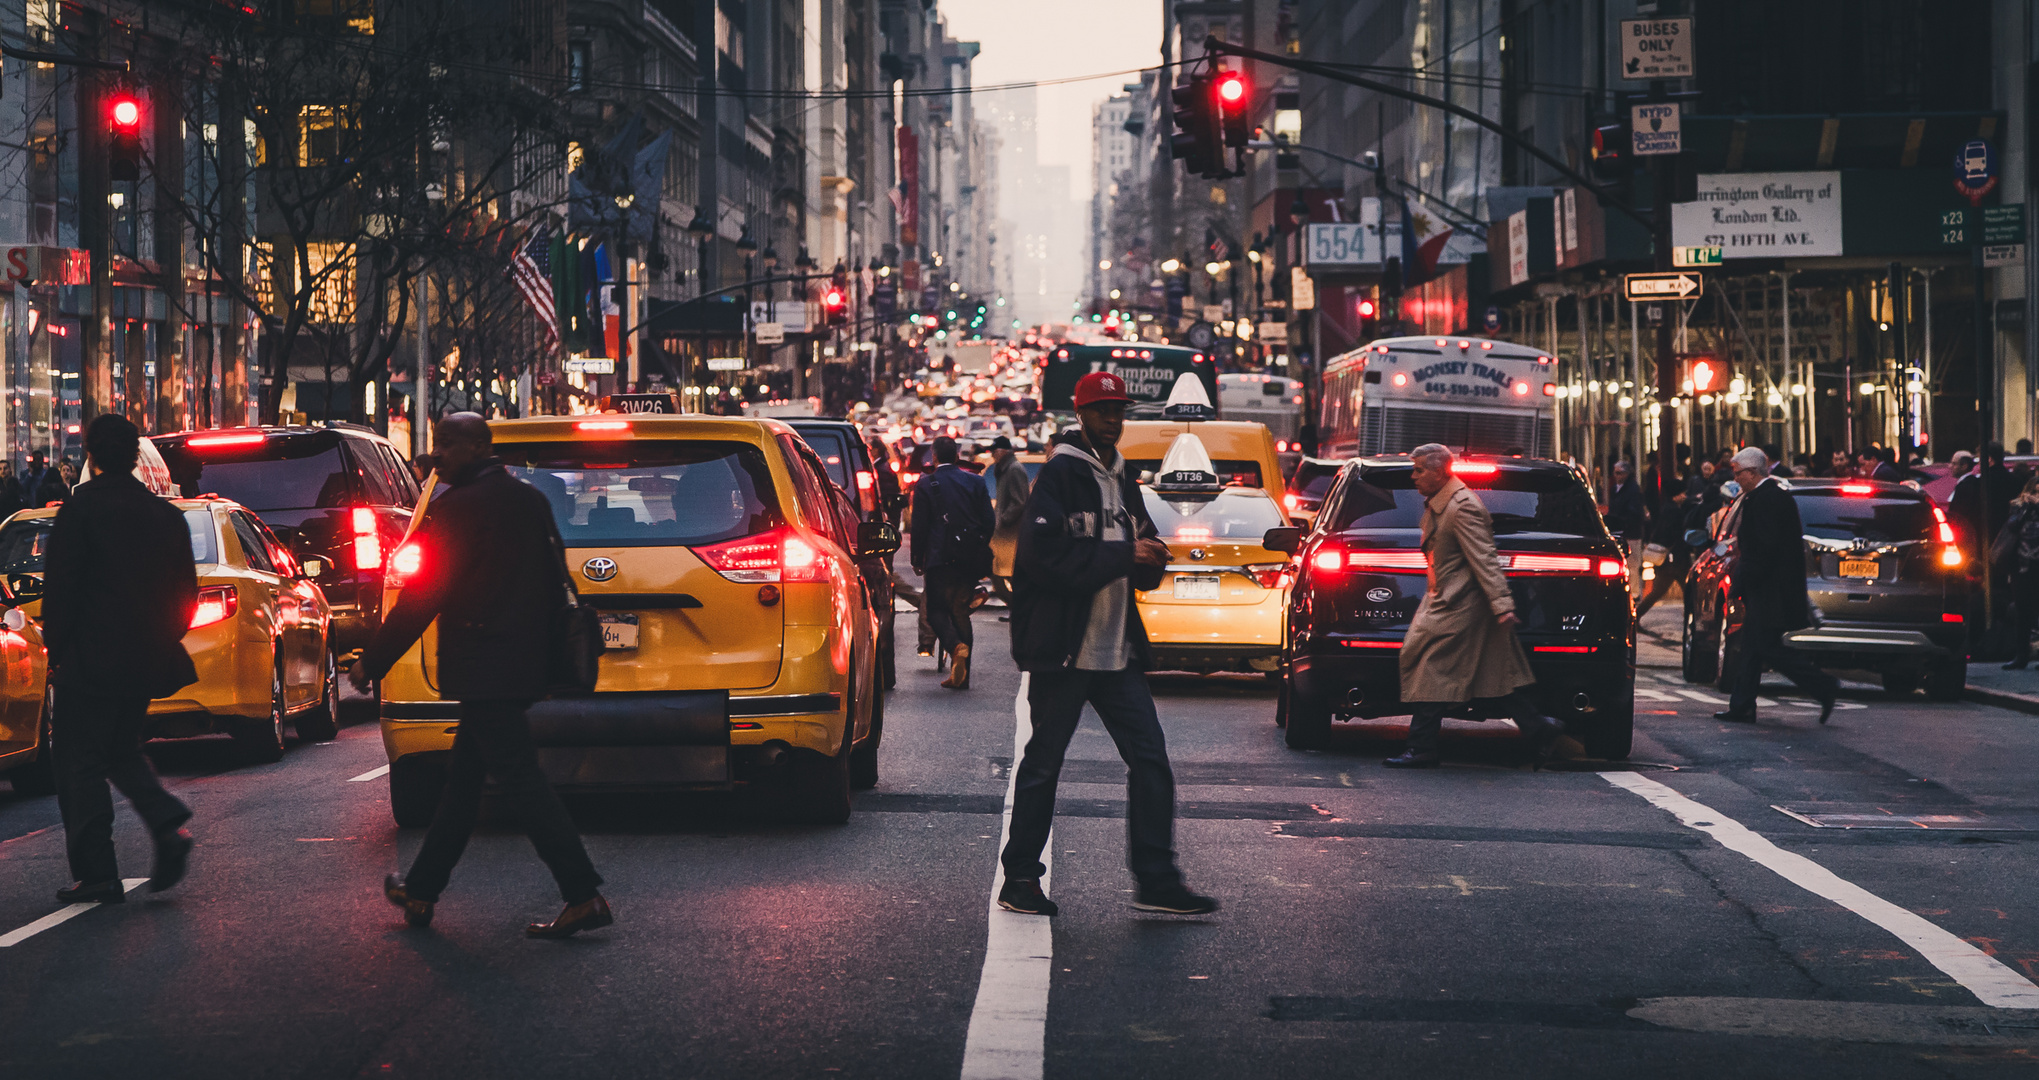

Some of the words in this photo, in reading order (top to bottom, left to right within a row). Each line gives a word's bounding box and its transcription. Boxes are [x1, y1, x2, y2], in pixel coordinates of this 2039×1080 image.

[1633, 23, 1679, 37] BUSES
[1639, 40, 1674, 52] ONLY
[1639, 106, 1672, 118] NYPD
[1633, 131, 1679, 142] SECURITY
[1637, 141, 1678, 151] CAMERA
[1762, 182, 1814, 203] Gallery
[1817, 182, 1832, 199] of
[1712, 207, 1767, 224] London
[1771, 206, 1801, 222] Ltd.
[1315, 226, 1365, 261] 554
[1704, 235, 1725, 246] 572
[1732, 233, 1776, 246] FIFTH
[1782, 232, 1814, 245] AVE.
[1637, 283, 1657, 291] ONE
[1668, 281, 1690, 290] WAY
[1413, 361, 1468, 383] MONSEY
[1472, 363, 1513, 388] TRAILS
[620, 400, 663, 414] 3W26
[1177, 405, 1202, 414] 3R14
[1176, 472, 1203, 481] 9T36
[1353, 610, 1403, 618] LINCOLN
